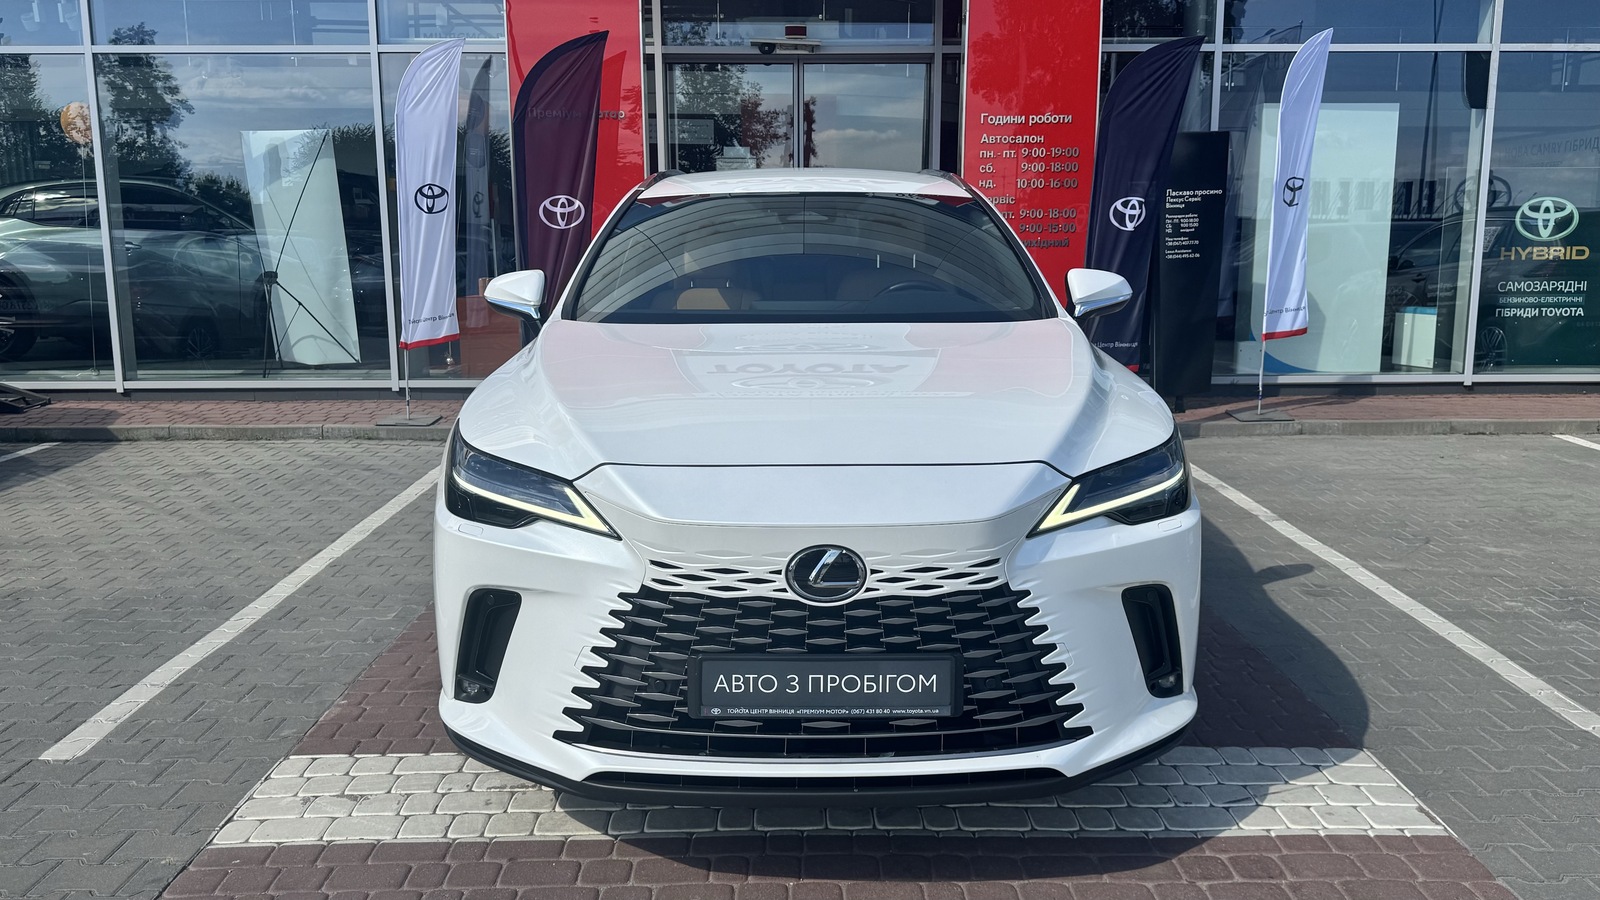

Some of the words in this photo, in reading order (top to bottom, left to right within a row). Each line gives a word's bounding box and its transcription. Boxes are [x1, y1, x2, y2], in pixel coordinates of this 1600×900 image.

[980, 112, 1026, 126] Години
[1028, 112, 1073, 126] роботи
[980, 133, 1044, 144] Автосалон
[1021, 147, 1079, 158] 9:00-19:00
[980, 162, 996, 173] сб.
[1021, 161, 1079, 172] 9:00-18:00
[979, 179, 996, 189] нд.
[1016, 178, 1078, 189] 10:00-16:00
[1019, 208, 1077, 219] 9:00-18:00
[1019, 222, 1076, 234] 9:00-15:00
[1501, 246, 1590, 261] HYBRID
[1497, 280, 1588, 293] САМОЗАРЯДНІ
[1495, 307, 1539, 318] ГІБРИДИ
[1541, 307, 1585, 317] TOYOTA
[714, 674, 778, 693] АВТО
[808, 674, 937, 693] ПРОБІГОМ
